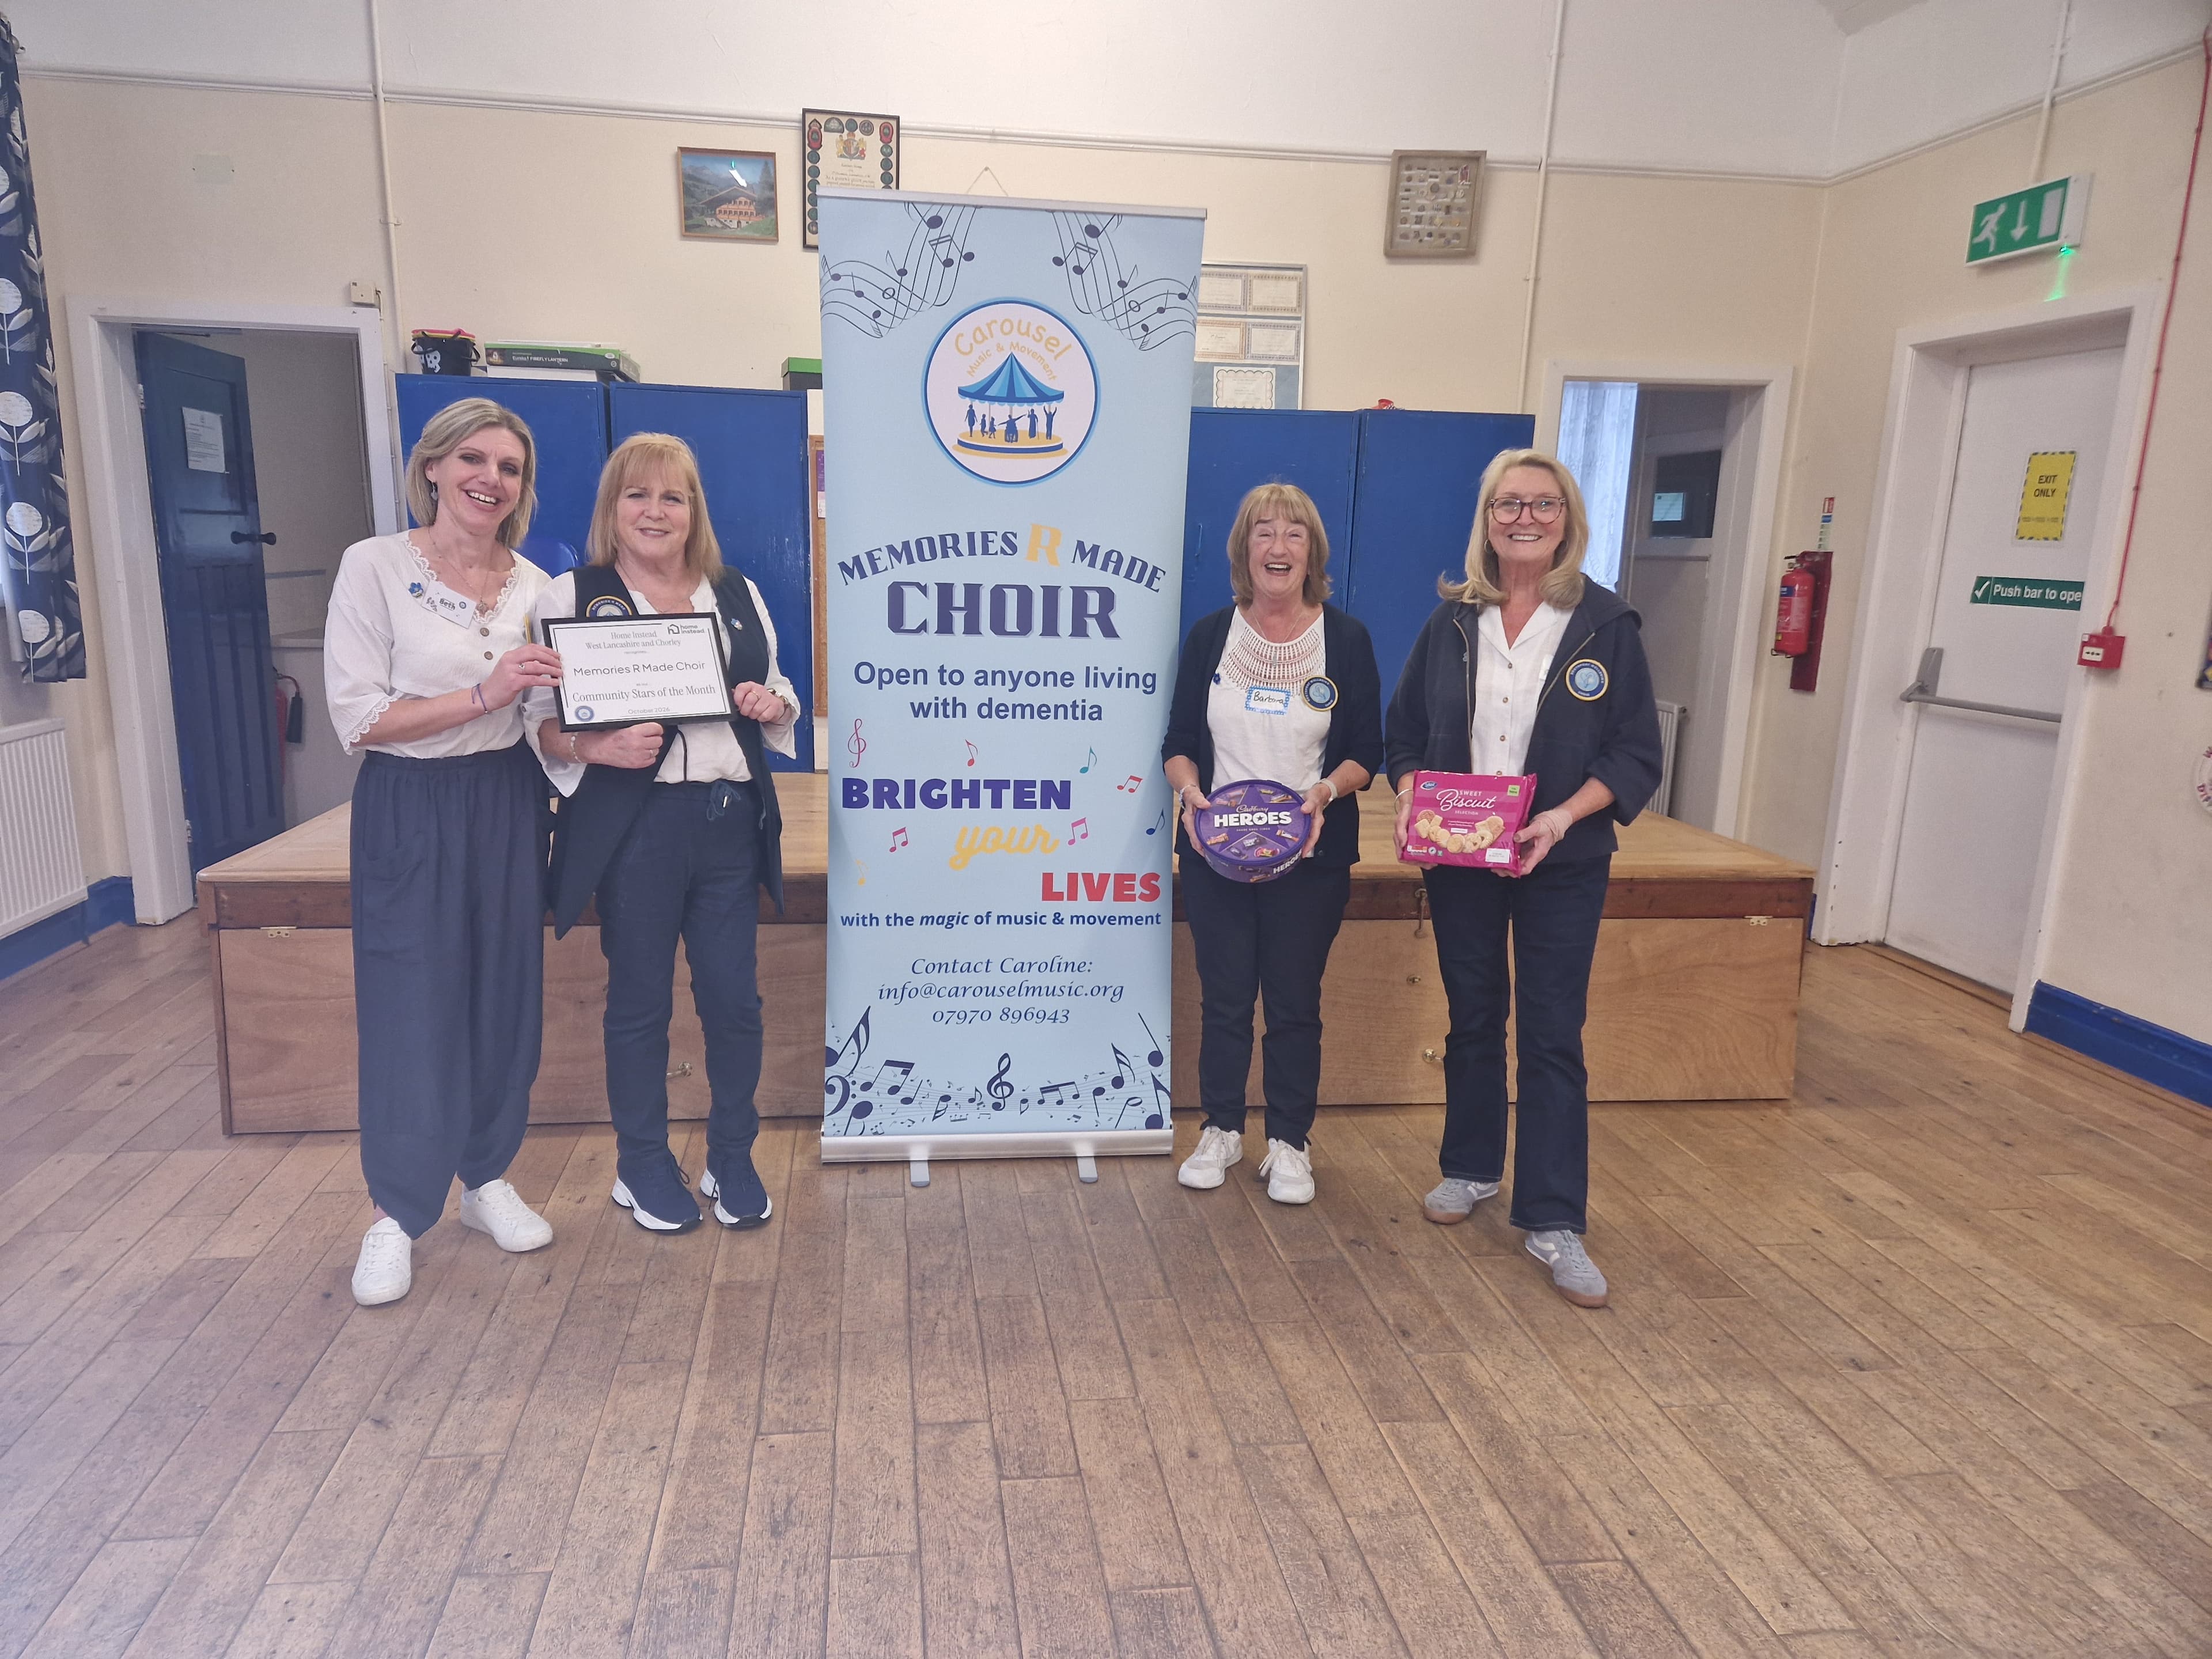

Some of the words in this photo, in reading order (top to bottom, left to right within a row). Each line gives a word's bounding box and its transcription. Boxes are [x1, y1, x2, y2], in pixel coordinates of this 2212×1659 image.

[955, 318, 1072, 360] Carousel
[966, 349, 992, 377] Music
[996, 343, 1004, 352] &
[1009, 342, 1058, 381] Movement
[2037, 475, 2058, 484] EXIT
[2033, 488, 2056, 498] ONLY
[837, 531, 1017, 586] MEMORIES
[1025, 523, 1062, 567] R
[1071, 540, 1166, 593] MADE
[1993, 584, 2020, 597] Push
[2023, 585, 2043, 599] bar
[2045, 588, 2056, 600] to
[440, 598, 455, 610] Beth
[888, 581, 1121, 639] CHOIR
[604, 640, 640, 649] Lancashire
[656, 639, 681, 647] Chorley
[574, 665, 630, 676] Memories
[632, 664, 640, 673] R
[642, 663, 673, 673] Made
[676, 661, 706, 671] Choir
[854, 661, 928, 690] Open
[938, 664, 964, 686] to
[974, 669, 1074, 692] anyone
[1085, 666, 1156, 694] living
[573, 690, 630, 702] Community
[631, 688, 656, 699] Stars
[657, 687, 666, 697] of
[669, 687, 683, 696] the
[685, 685, 716, 695] Month
[910, 697, 967, 719] with
[977, 698, 1103, 721] dementia
[842, 778, 1071, 810] BRIGHTEN
[1436, 789, 1497, 811] Biscuit
[1236, 804, 1268, 813] Cadbury
[1214, 811, 1292, 827] HEROES
[949, 824, 1059, 870] your
[1041, 872, 1161, 902] LIVES
[840, 913, 880, 927] with
[885, 912, 914, 927] the
[919, 911, 969, 929] magic
[974, 911, 992, 925] of
[997, 911, 1047, 925] music
[1052, 912, 1065, 925] &
[1070, 912, 1161, 926] movement
[911, 959, 993, 975] Contact
[999, 955, 1092, 974] Caroline:
[878, 980, 1123, 1005] info@carouselmusic.org
[933, 1010, 991, 1025] 07970
[999, 1007, 1070, 1024] 896943
